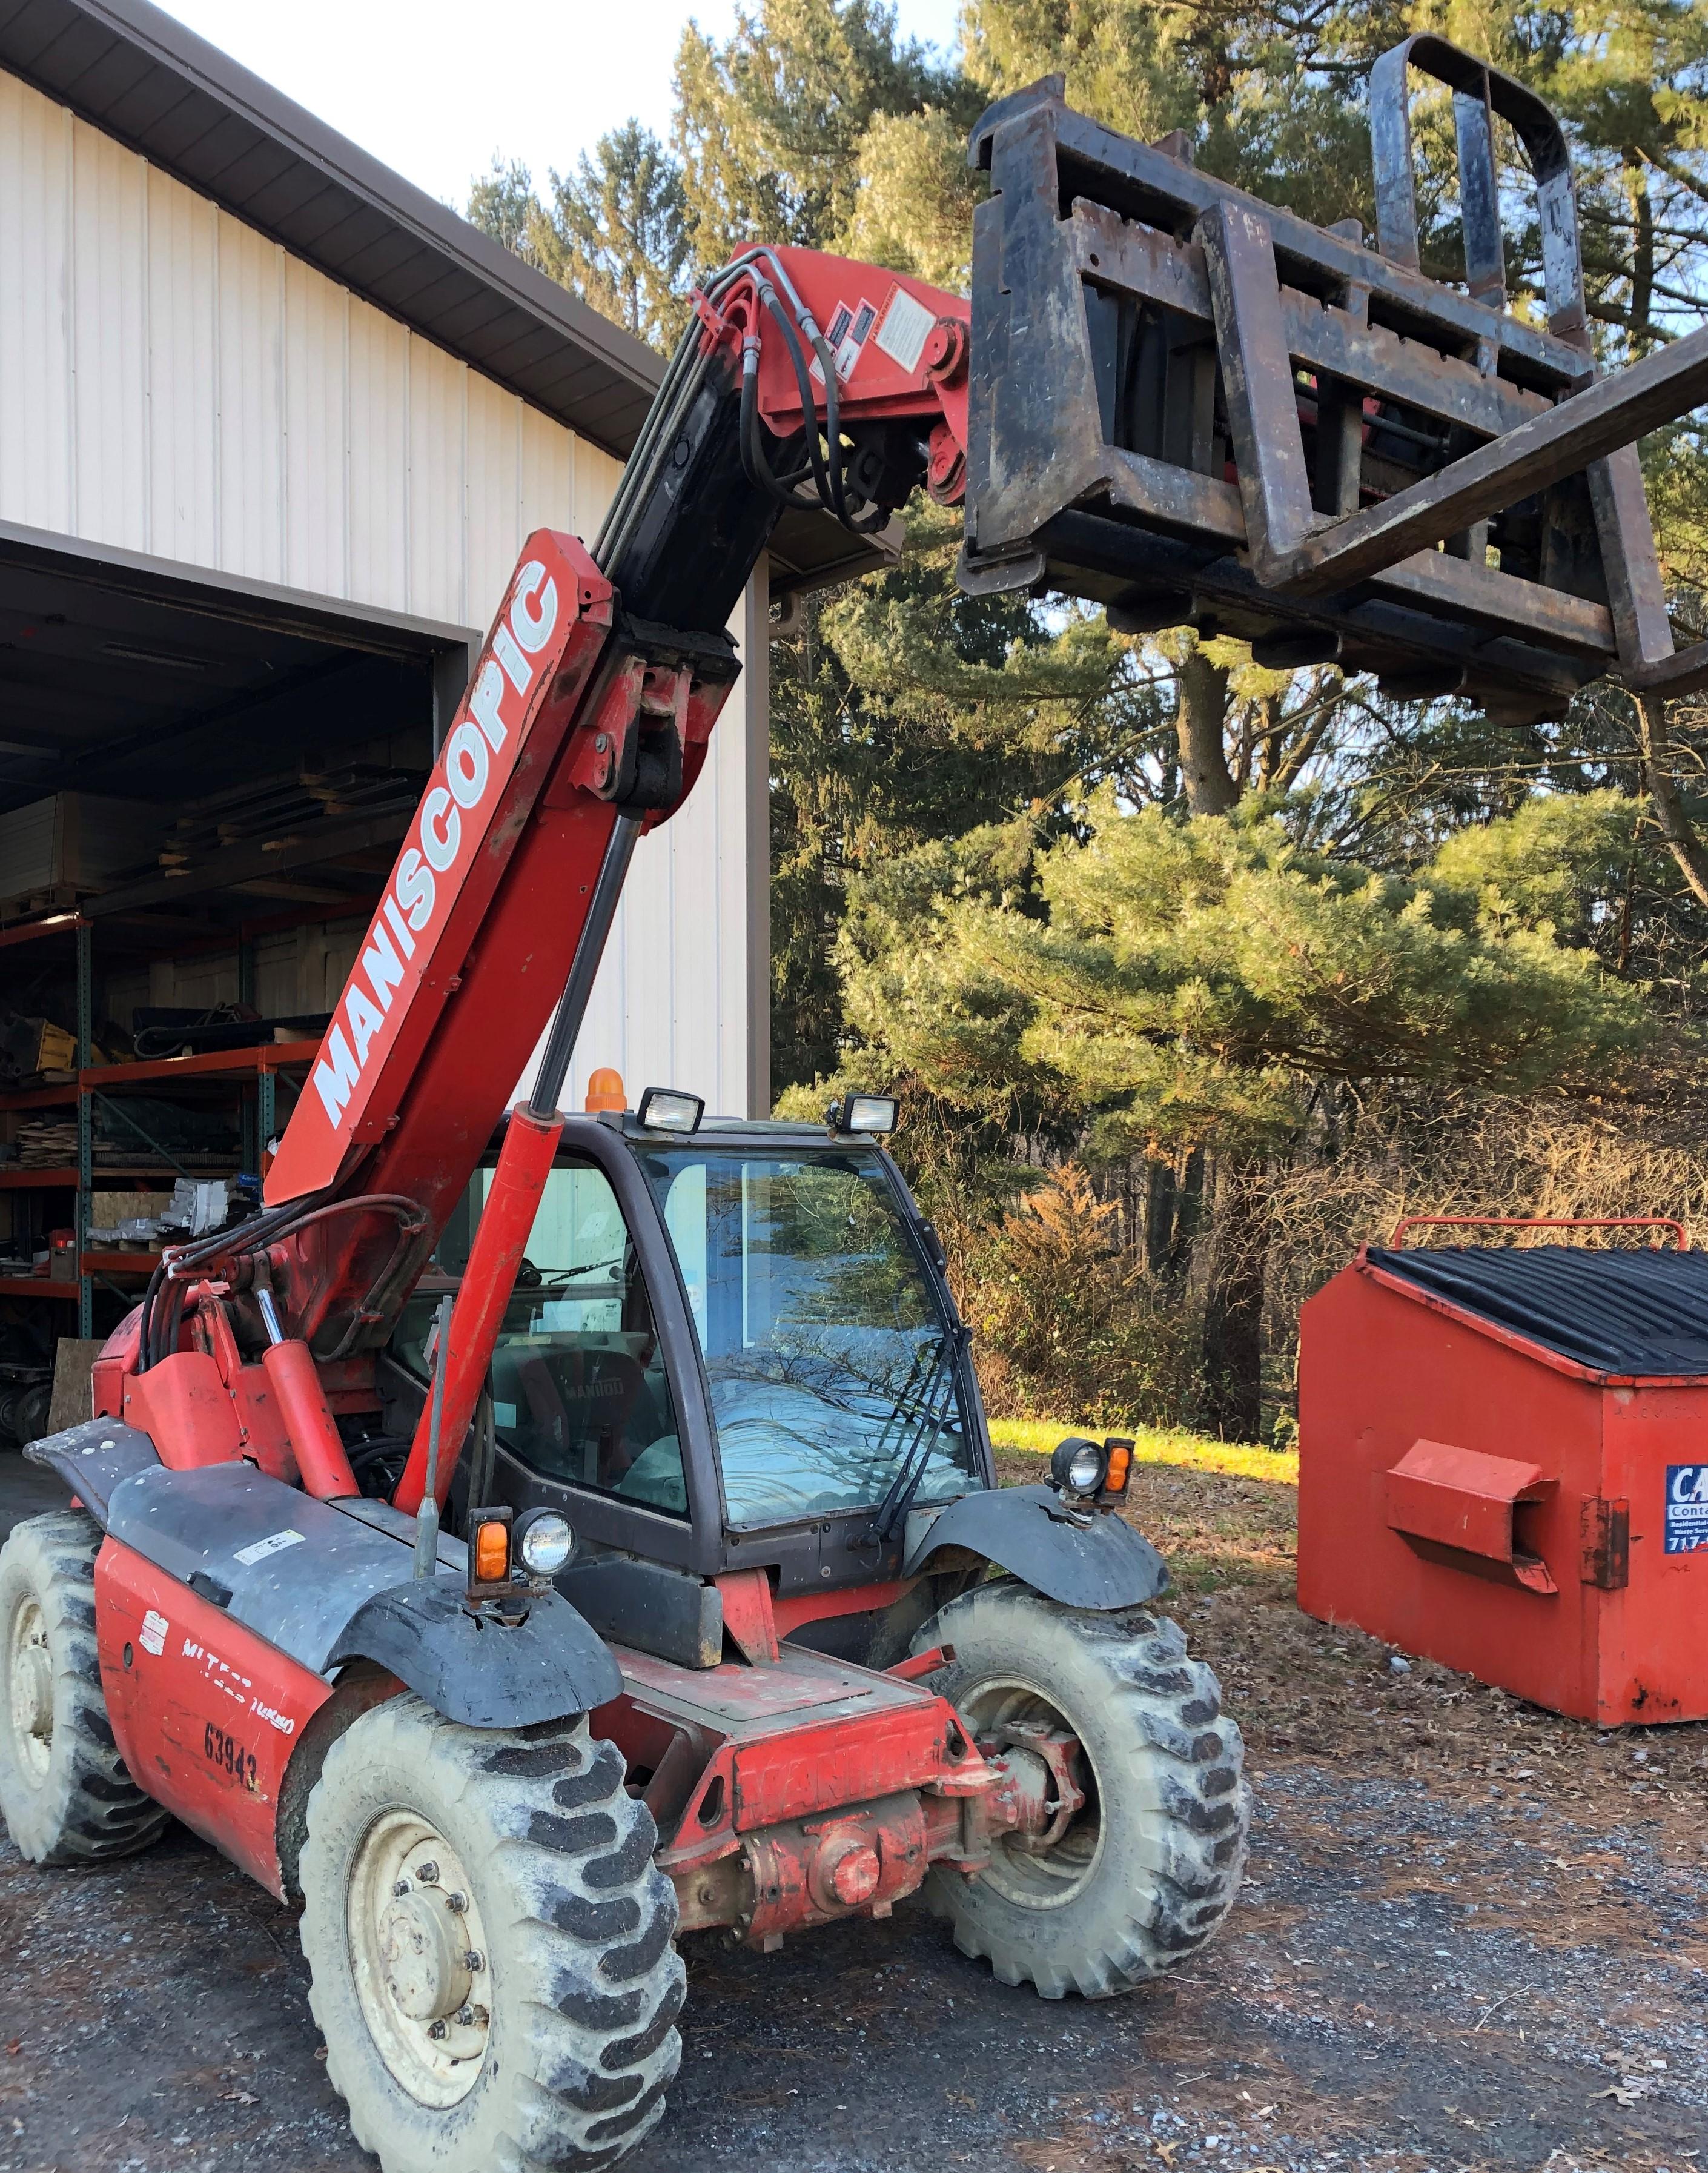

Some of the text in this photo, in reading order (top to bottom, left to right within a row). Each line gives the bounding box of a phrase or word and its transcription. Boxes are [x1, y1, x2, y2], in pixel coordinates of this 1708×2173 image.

[875, 285, 897, 330] WARNING
[312, 560, 559, 1130] MANISCOPIC
[1668, 1536, 1708, 1551] 717-
